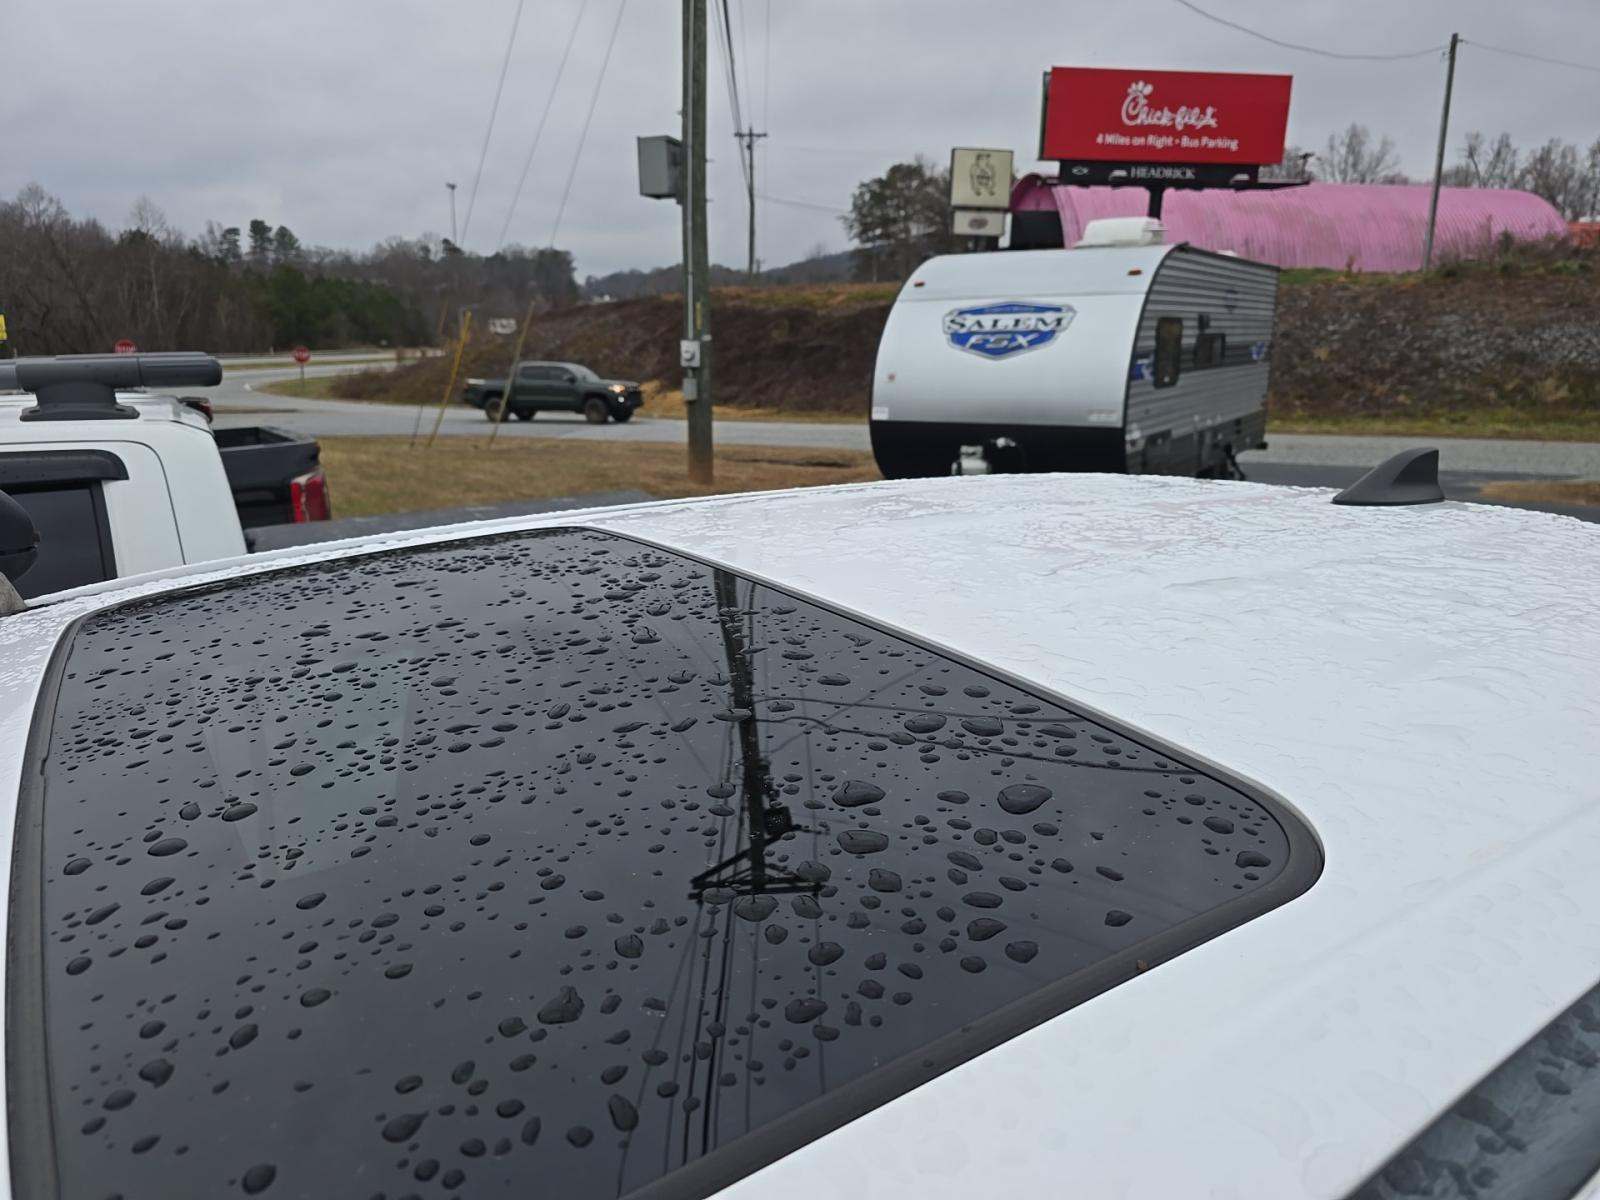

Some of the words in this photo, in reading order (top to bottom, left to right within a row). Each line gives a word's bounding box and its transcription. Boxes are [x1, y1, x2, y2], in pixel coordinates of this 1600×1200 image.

[1104, 133, 1130, 145] Miles
[1131, 136, 1146, 145] on
[1147, 134, 1173, 149] Right
[1181, 135, 1199, 148] Bus
[1200, 136, 1239, 151] Parking
[947, 316, 1064, 332] SALEM
[965, 333, 1040, 349] FSX
